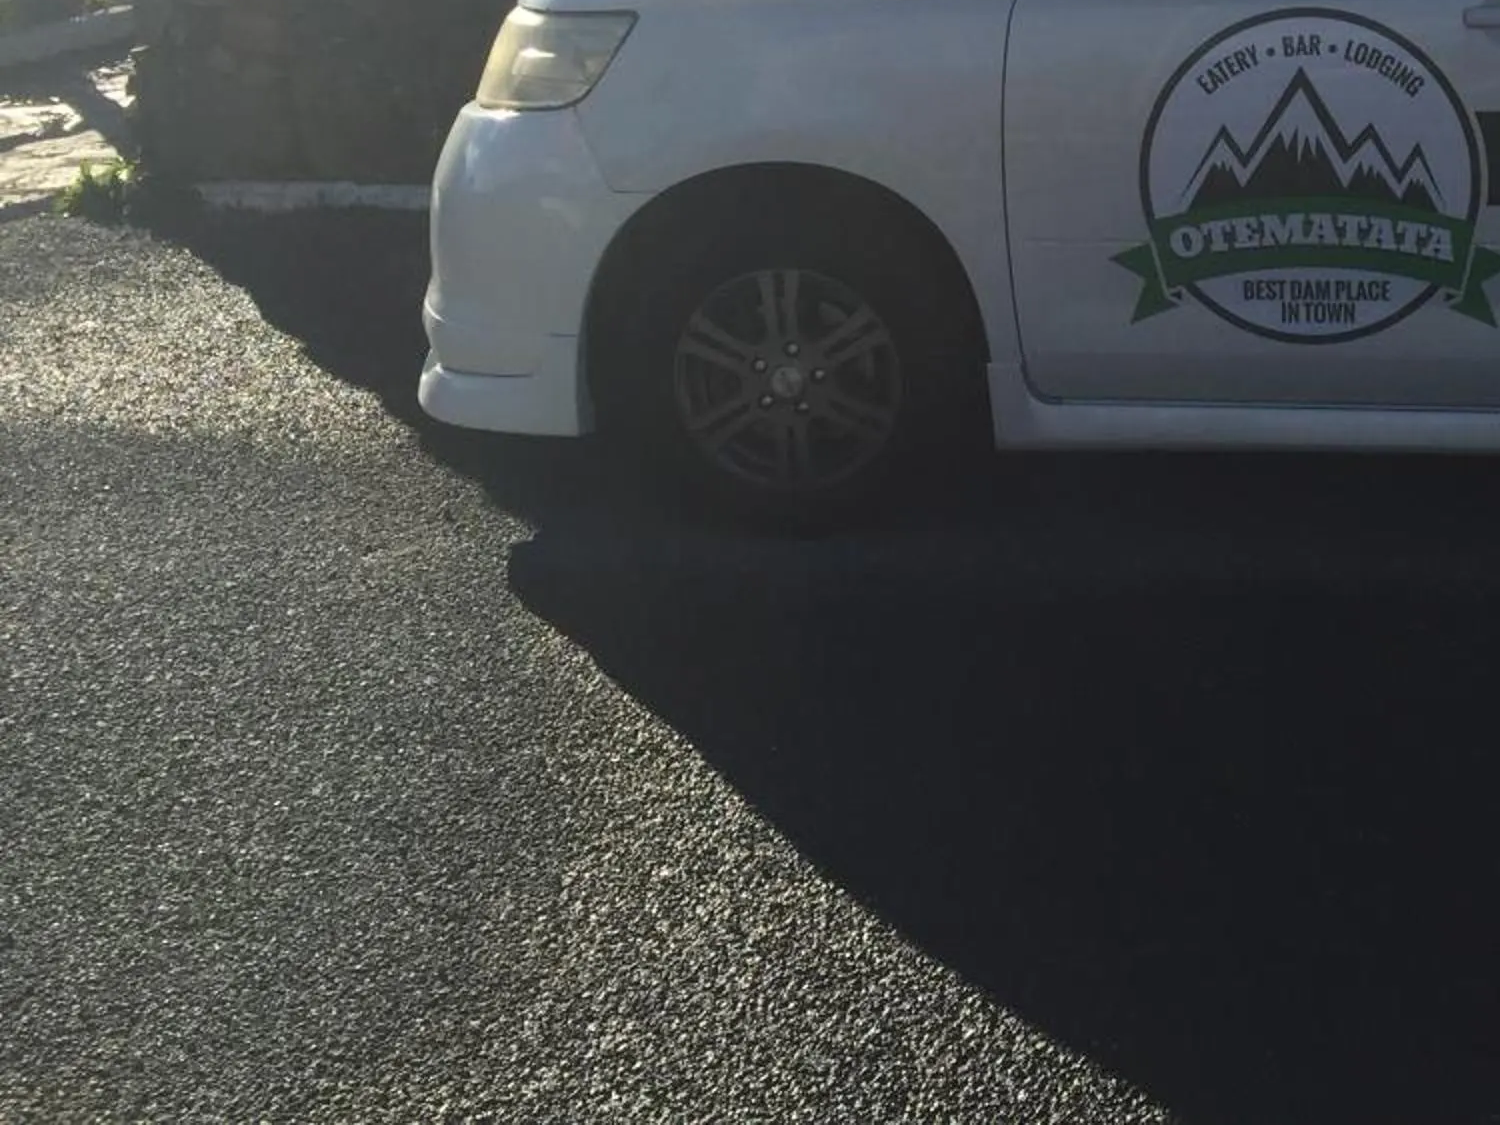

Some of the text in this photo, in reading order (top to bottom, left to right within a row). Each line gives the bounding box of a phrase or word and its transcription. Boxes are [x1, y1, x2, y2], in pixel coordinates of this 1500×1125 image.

[1196, 34, 1426, 98] EATERY BAR LODGING
[1170, 212, 1455, 263] OTEMATATA
[1243, 280, 1391, 302] BEST DAM PLACE
[1281, 302, 1356, 324] IN TOWN
